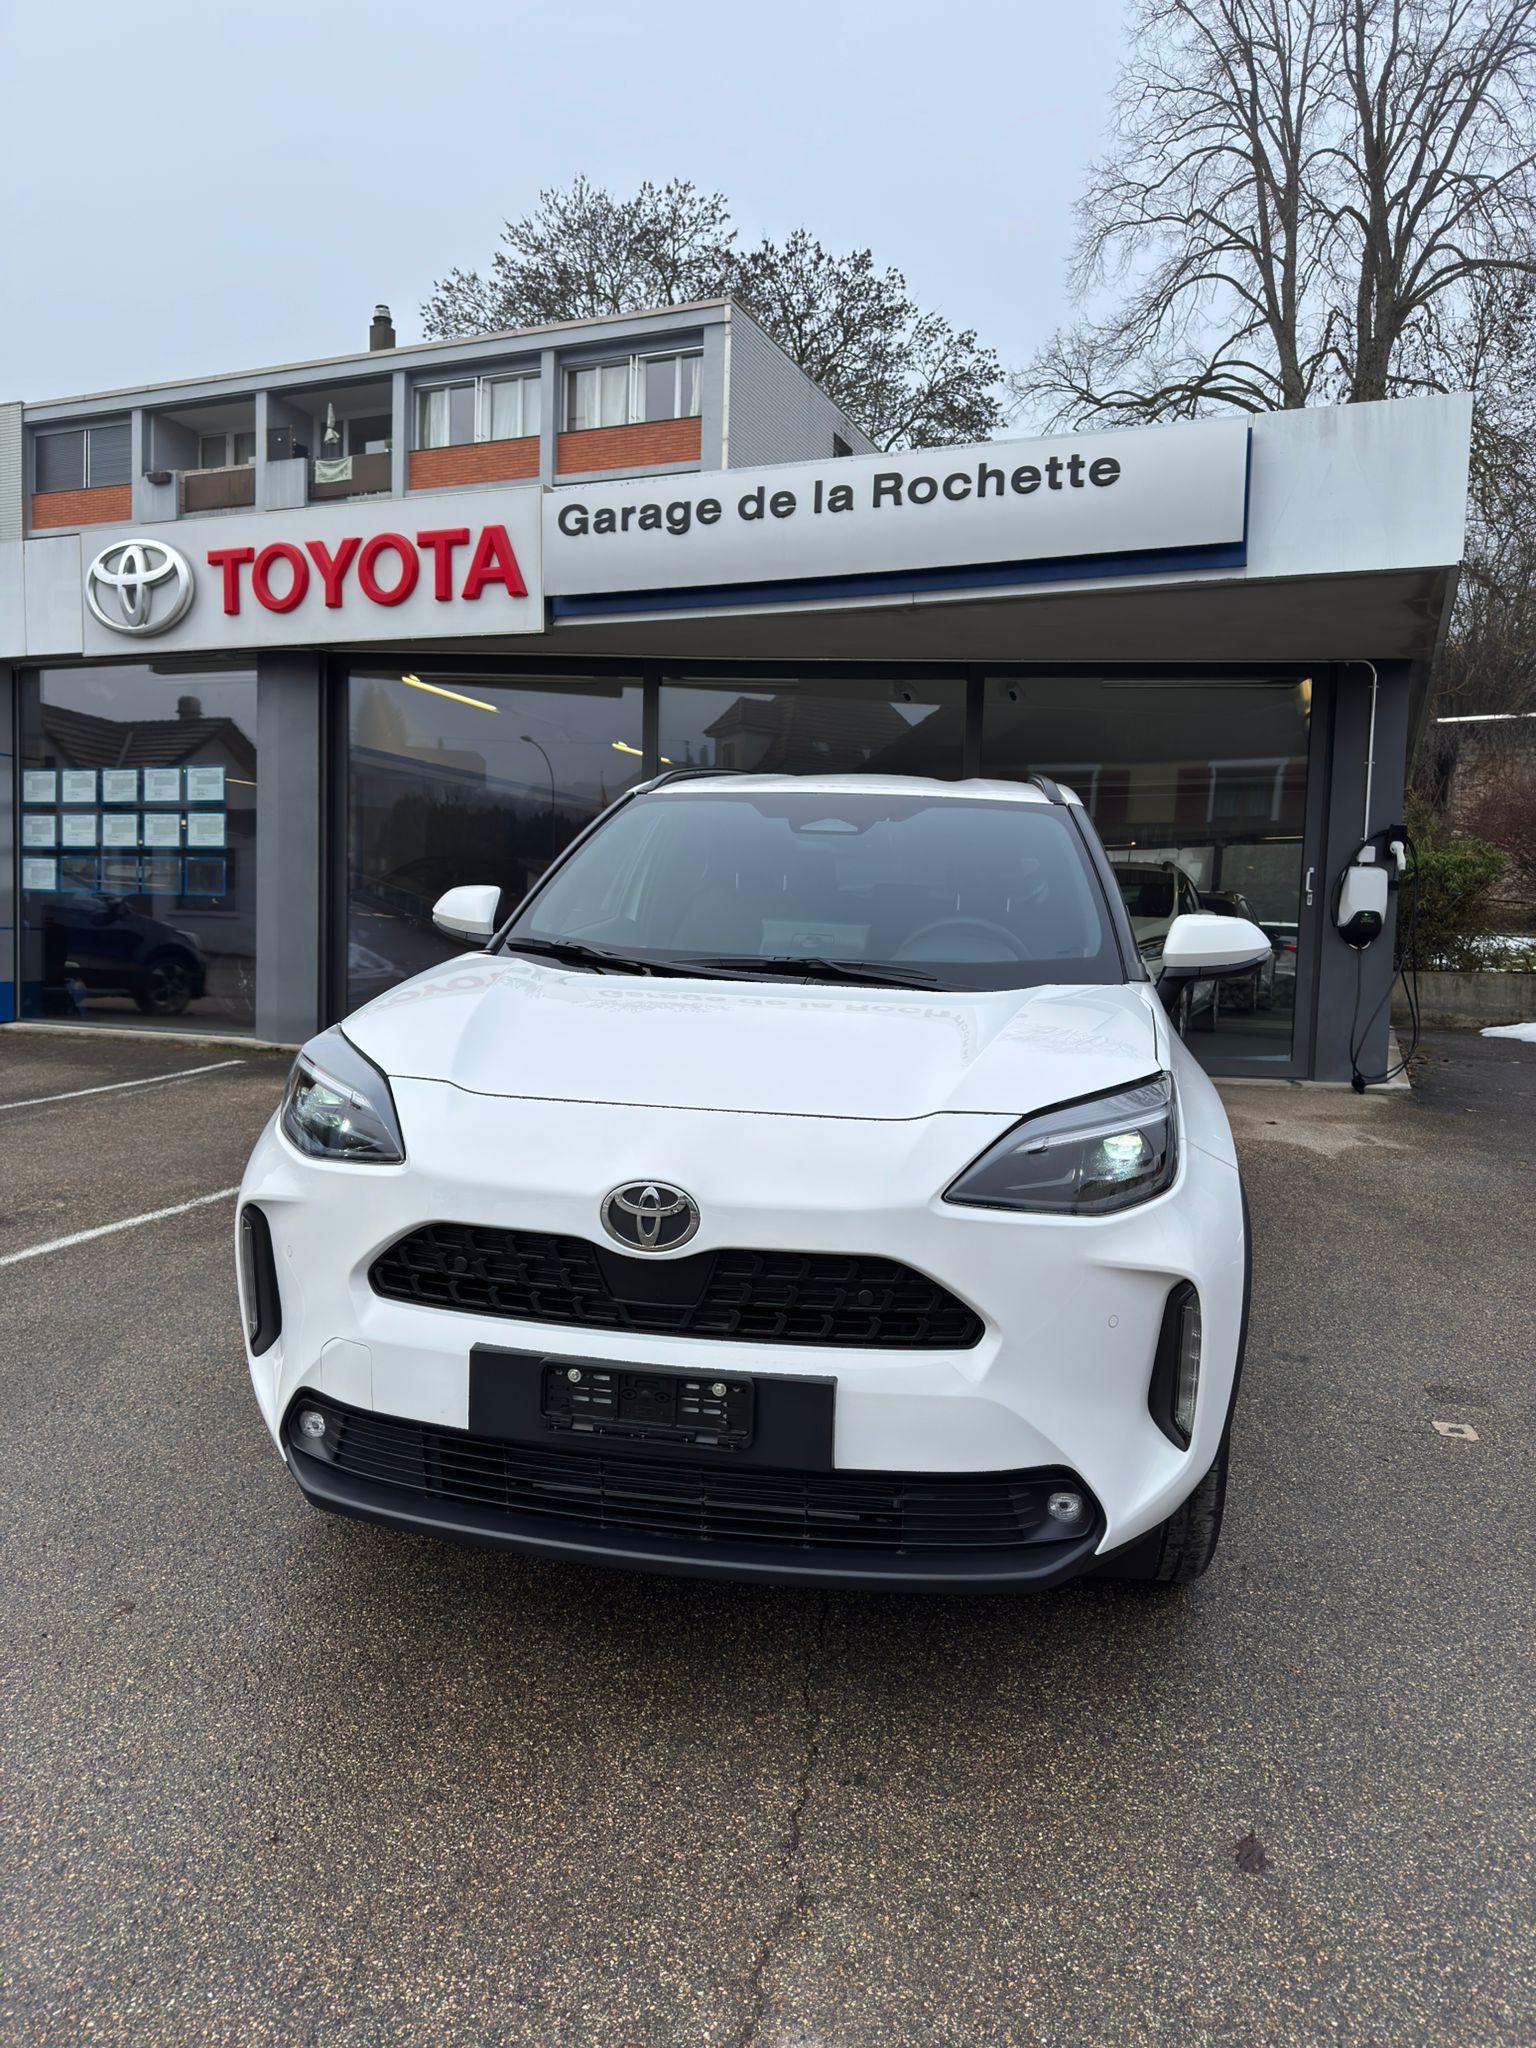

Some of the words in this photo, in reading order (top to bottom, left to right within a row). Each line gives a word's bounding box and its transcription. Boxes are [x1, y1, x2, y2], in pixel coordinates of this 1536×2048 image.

[558, 498, 722, 536] Garage
[738, 485, 796, 521] de
[813, 480, 854, 514] la
[873, 454, 1121, 508] Rochette
[207, 524, 528, 616] TOYOTA
